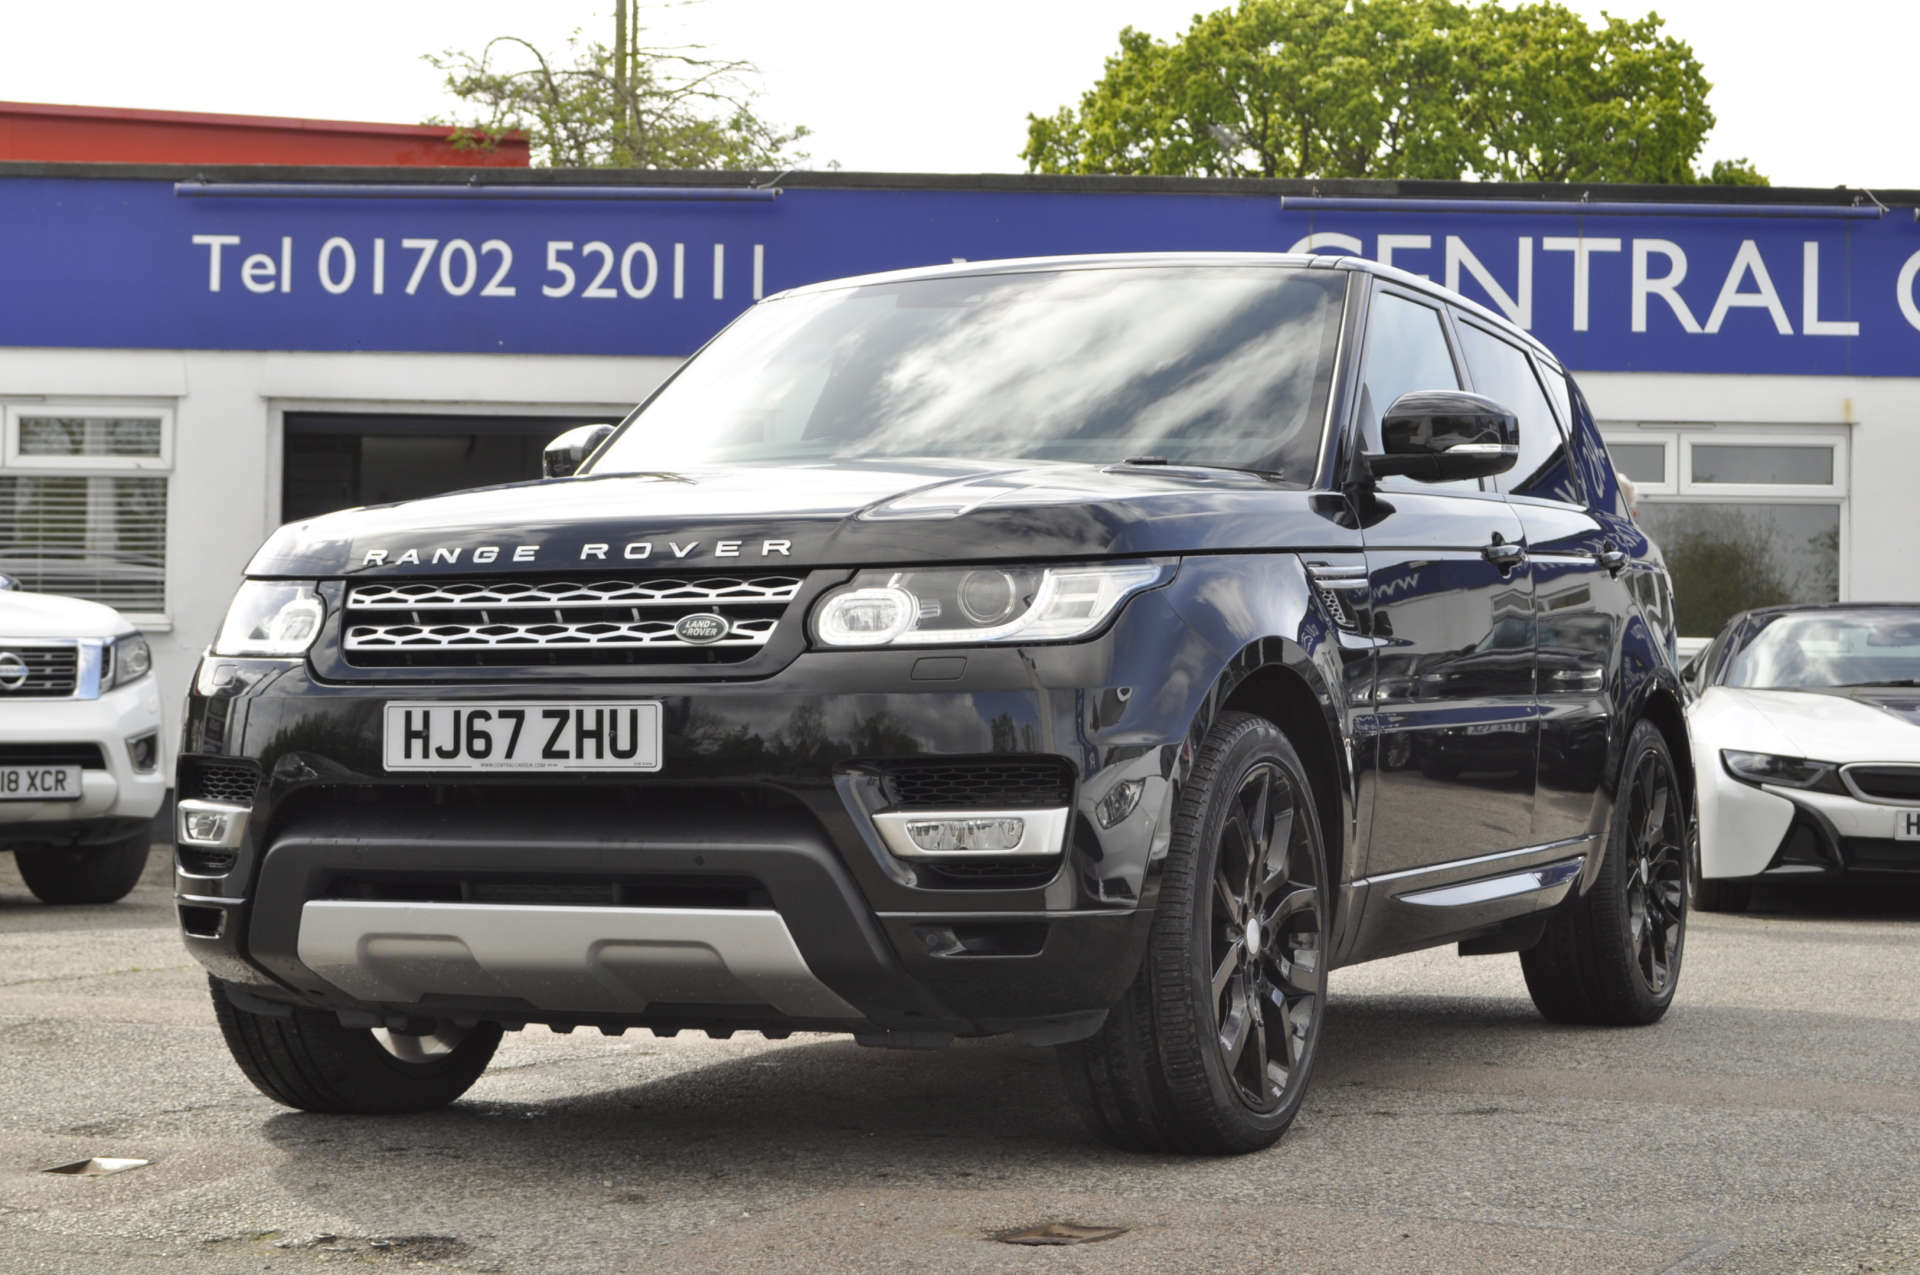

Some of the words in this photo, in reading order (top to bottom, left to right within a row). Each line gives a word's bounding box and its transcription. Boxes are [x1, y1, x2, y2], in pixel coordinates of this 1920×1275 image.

[193, 234, 292, 294] Tel
[318, 236, 516, 298] 01702
[542, 240, 765, 301] 520111
[1288, 231, 1860, 337] NTRAL
[362, 545, 540, 566] RANGE
[580, 537, 795, 561] ROVER
[685, 620, 711, 629] LAND
[686, 627, 718, 637] ROVER
[404, 705, 526, 760] HJ67
[541, 704, 639, 760] ZHU
[26, 769, 67, 792] XCR
